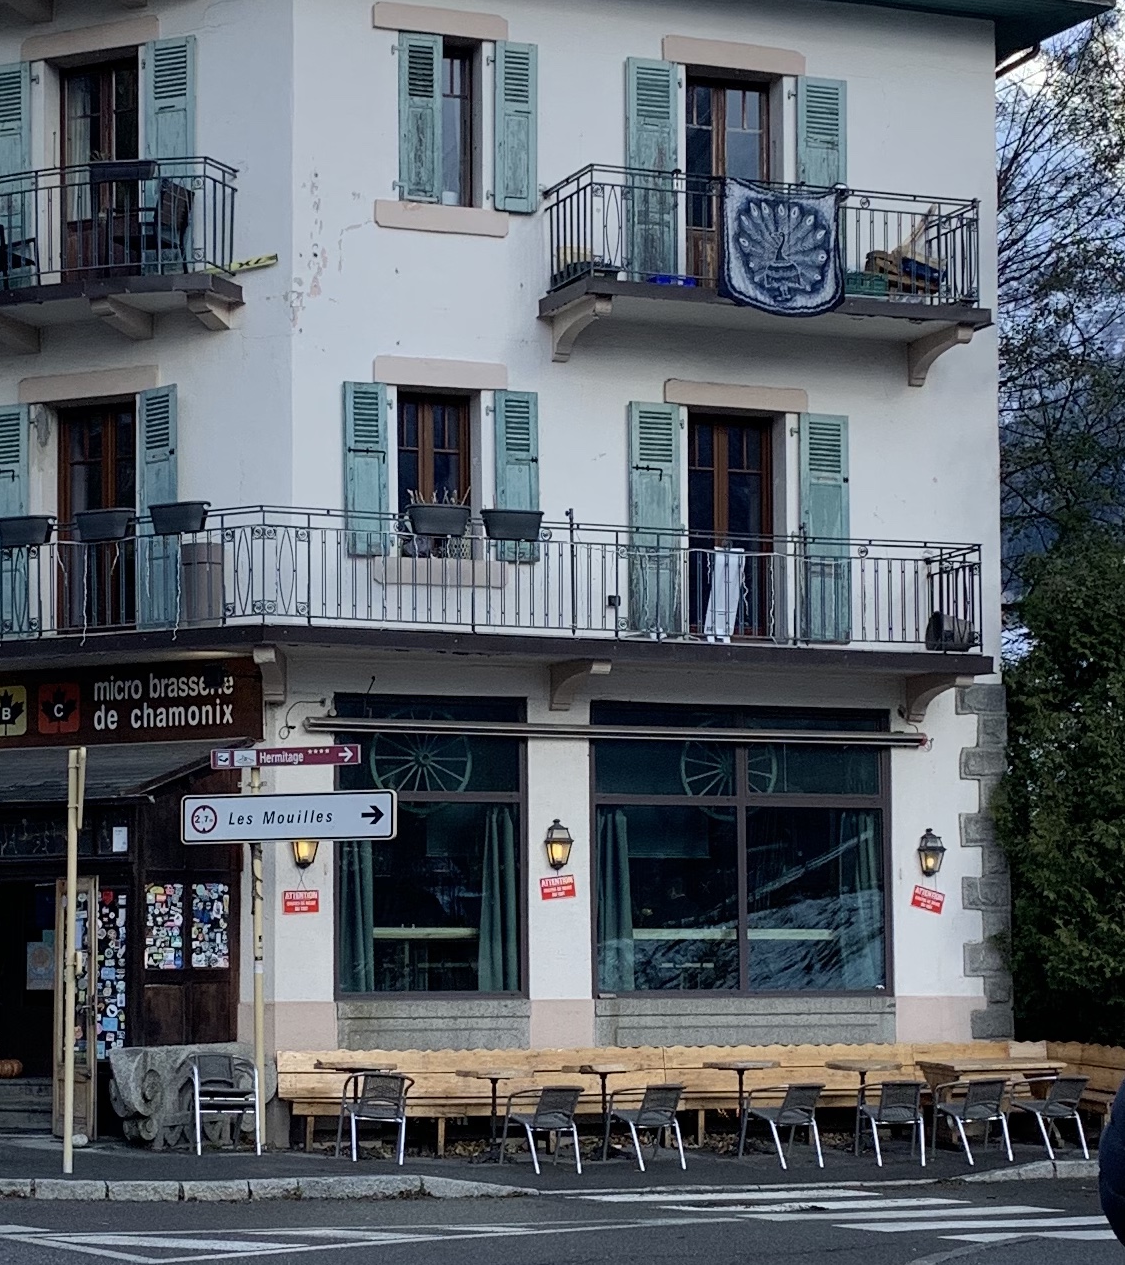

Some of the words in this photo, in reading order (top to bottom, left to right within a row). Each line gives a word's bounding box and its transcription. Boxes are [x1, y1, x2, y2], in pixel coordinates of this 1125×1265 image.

[93, 676, 142, 702] micro
[149, 673, 234, 698] brassee
[1, 707, 11, 721] B
[54, 703, 64, 718] C
[93, 708, 118, 731] de
[130, 698, 234, 729] chamonix
[259, 750, 304, 764] Hermitage
[228, 812, 253, 826] Les
[262, 810, 333, 825] Mouilles
